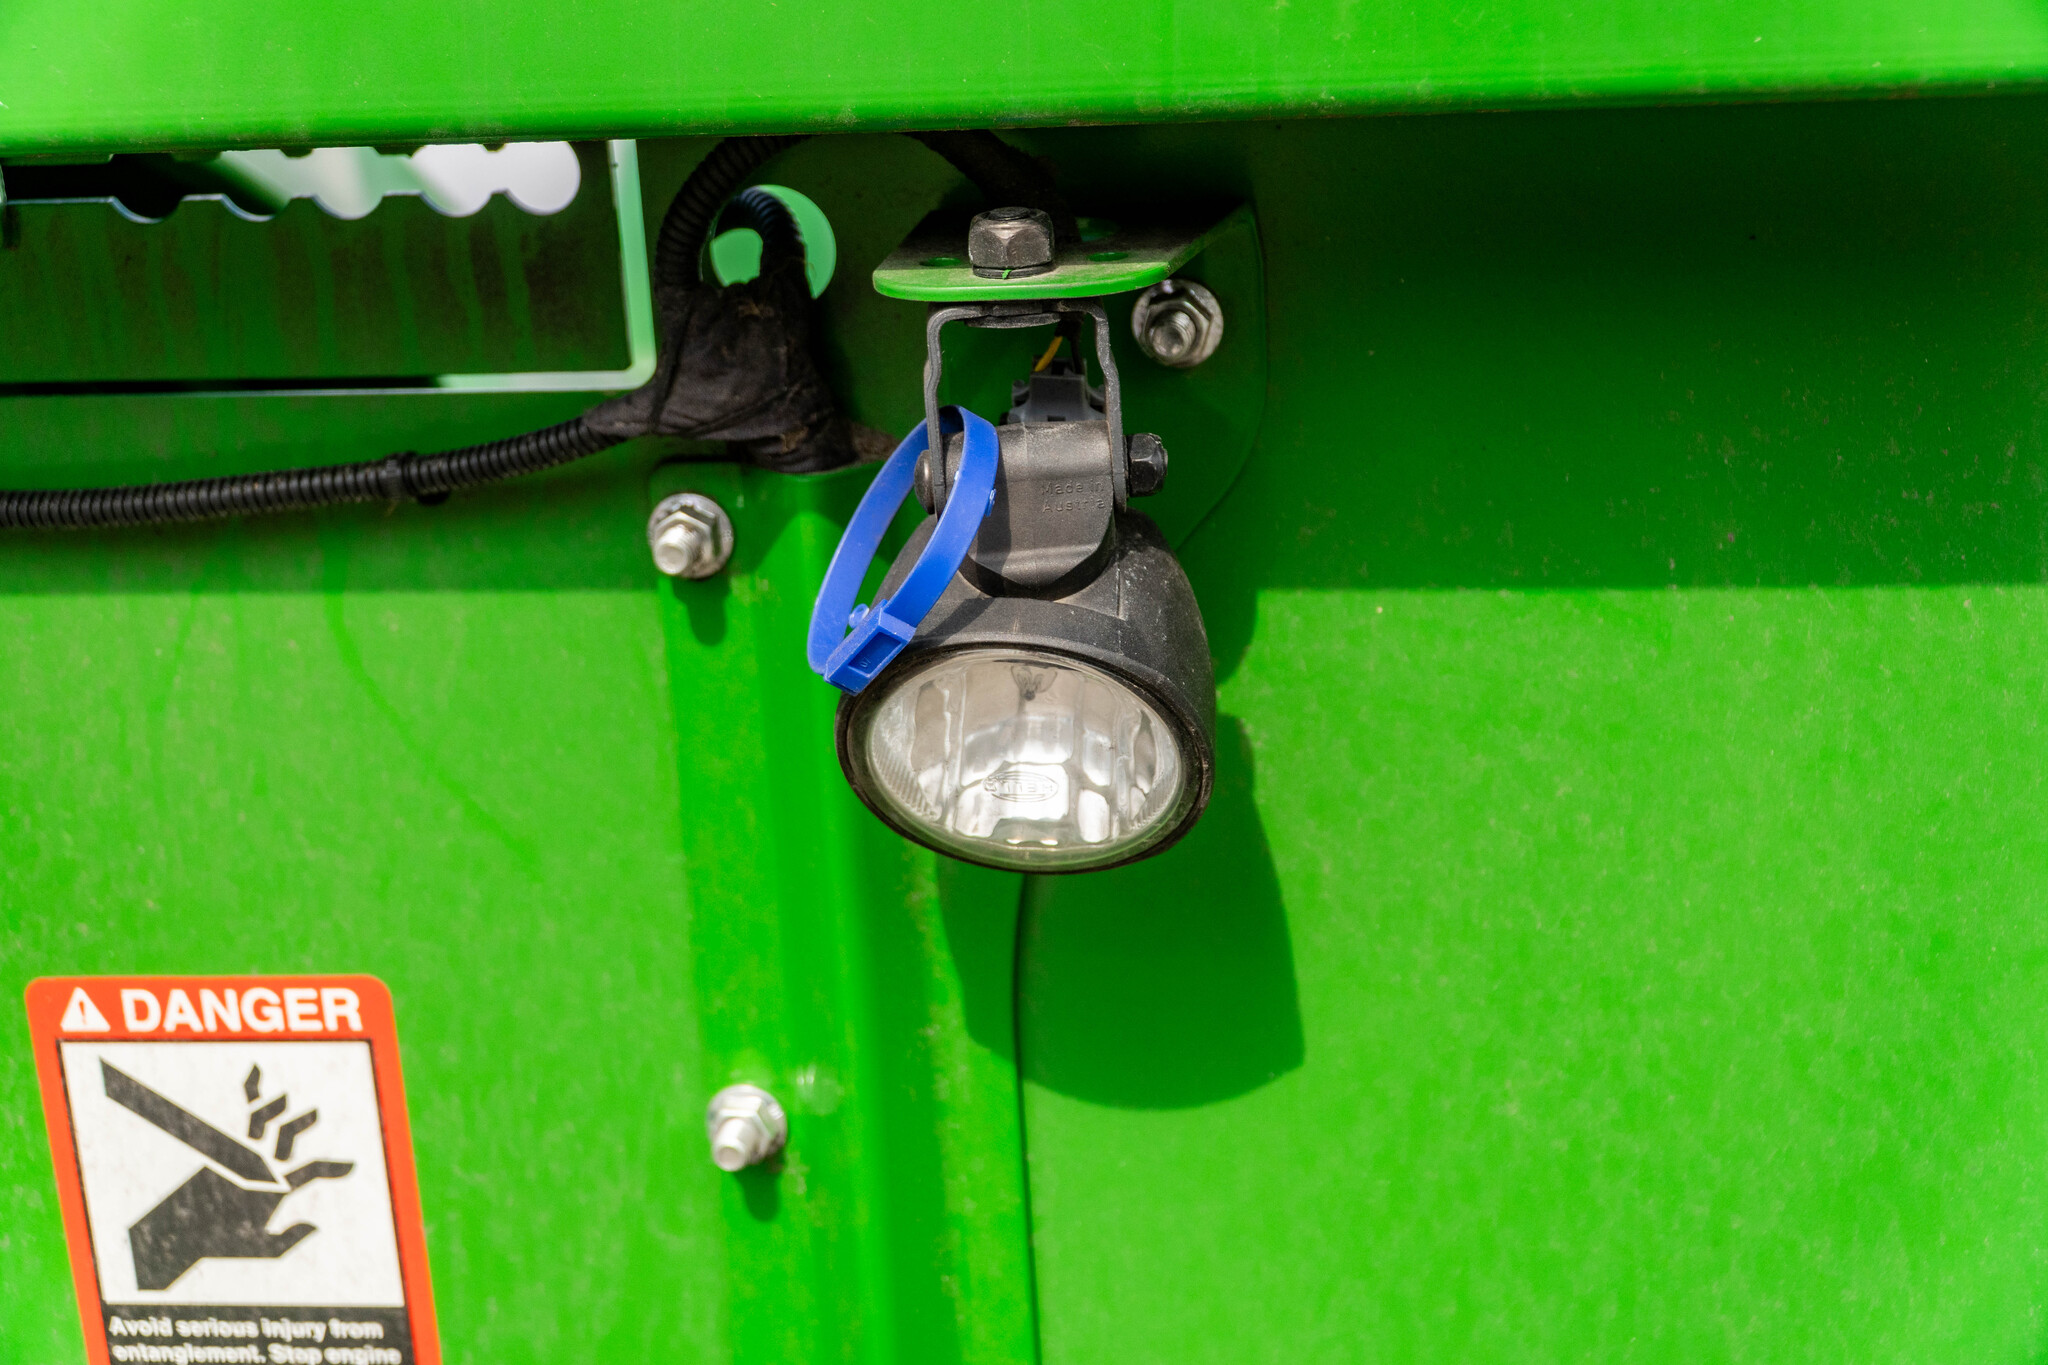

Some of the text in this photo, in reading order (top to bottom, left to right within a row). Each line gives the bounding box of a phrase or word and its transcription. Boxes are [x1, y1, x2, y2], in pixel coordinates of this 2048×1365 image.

[1041, 478, 1104, 496] Made in
[1041, 496, 1106, 513] Austria
[119, 987, 363, 1032] DANGER
[109, 1315, 384, 1343] Avoid serious injury from
[112, 1343, 402, 1365] entanglement. Stop engine
